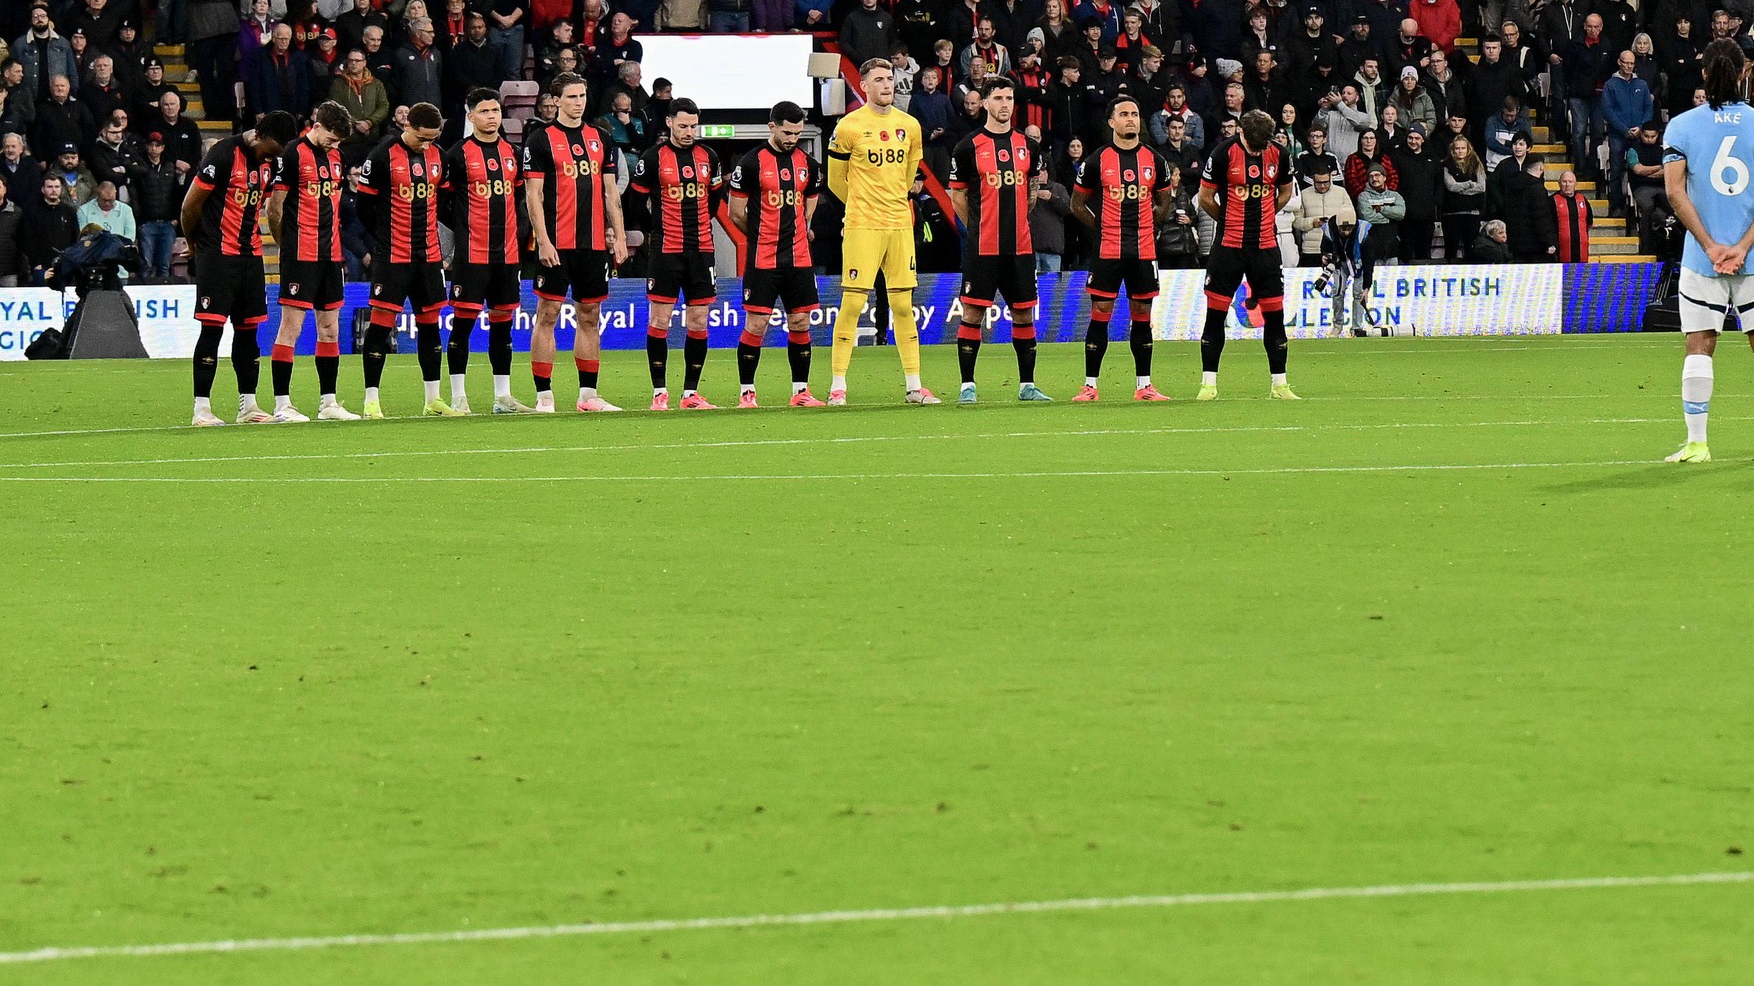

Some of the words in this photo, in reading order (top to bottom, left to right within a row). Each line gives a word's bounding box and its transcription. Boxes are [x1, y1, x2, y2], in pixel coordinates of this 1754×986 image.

[1714, 110, 1741, 125] AKÉ
[868, 148, 905, 167] bj88
[1709, 135, 1750, 196] 6
[563, 161, 600, 180] bj88
[986, 170, 1025, 190] bj88
[399, 182, 436, 202] bj88
[475, 180, 513, 199] bj88
[667, 183, 706, 203] bj88
[1109, 183, 1148, 203] bj88
[1235, 184, 1270, 202] bj88
[768, 191, 803, 209] bj88
[1397, 277, 1500, 298] BRITISH
